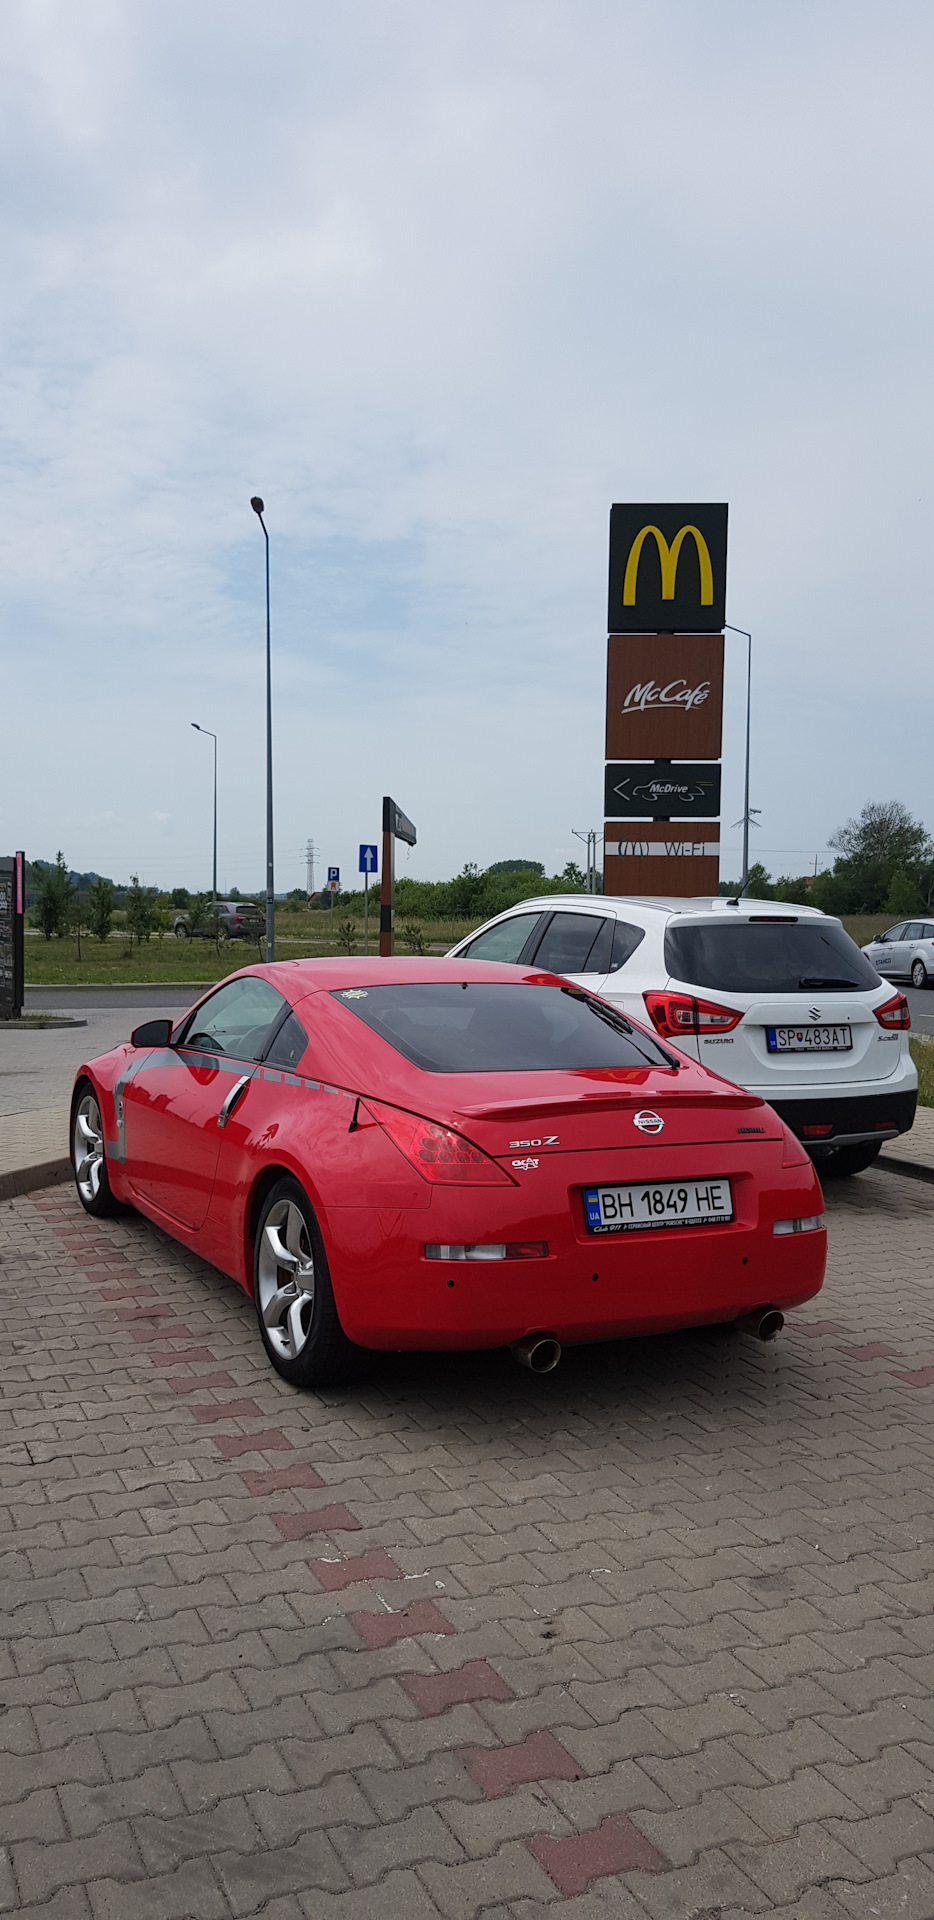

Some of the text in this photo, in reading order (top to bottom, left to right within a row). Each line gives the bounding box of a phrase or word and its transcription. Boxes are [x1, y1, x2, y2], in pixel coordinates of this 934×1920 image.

[621, 679, 711, 714] McCafé
[649, 783, 688, 793] McDrive
[664, 841, 705, 857] Wi-Fi
[330, 868, 338, 879] P
[778, 1028, 847, 1046] SP 483AT
[601, 1186, 724, 1219] BH 1849 HE
[589, 1212, 600, 1221] UA
[593, 1225, 608, 1233] Club
[609, 1224, 622, 1232] 911
